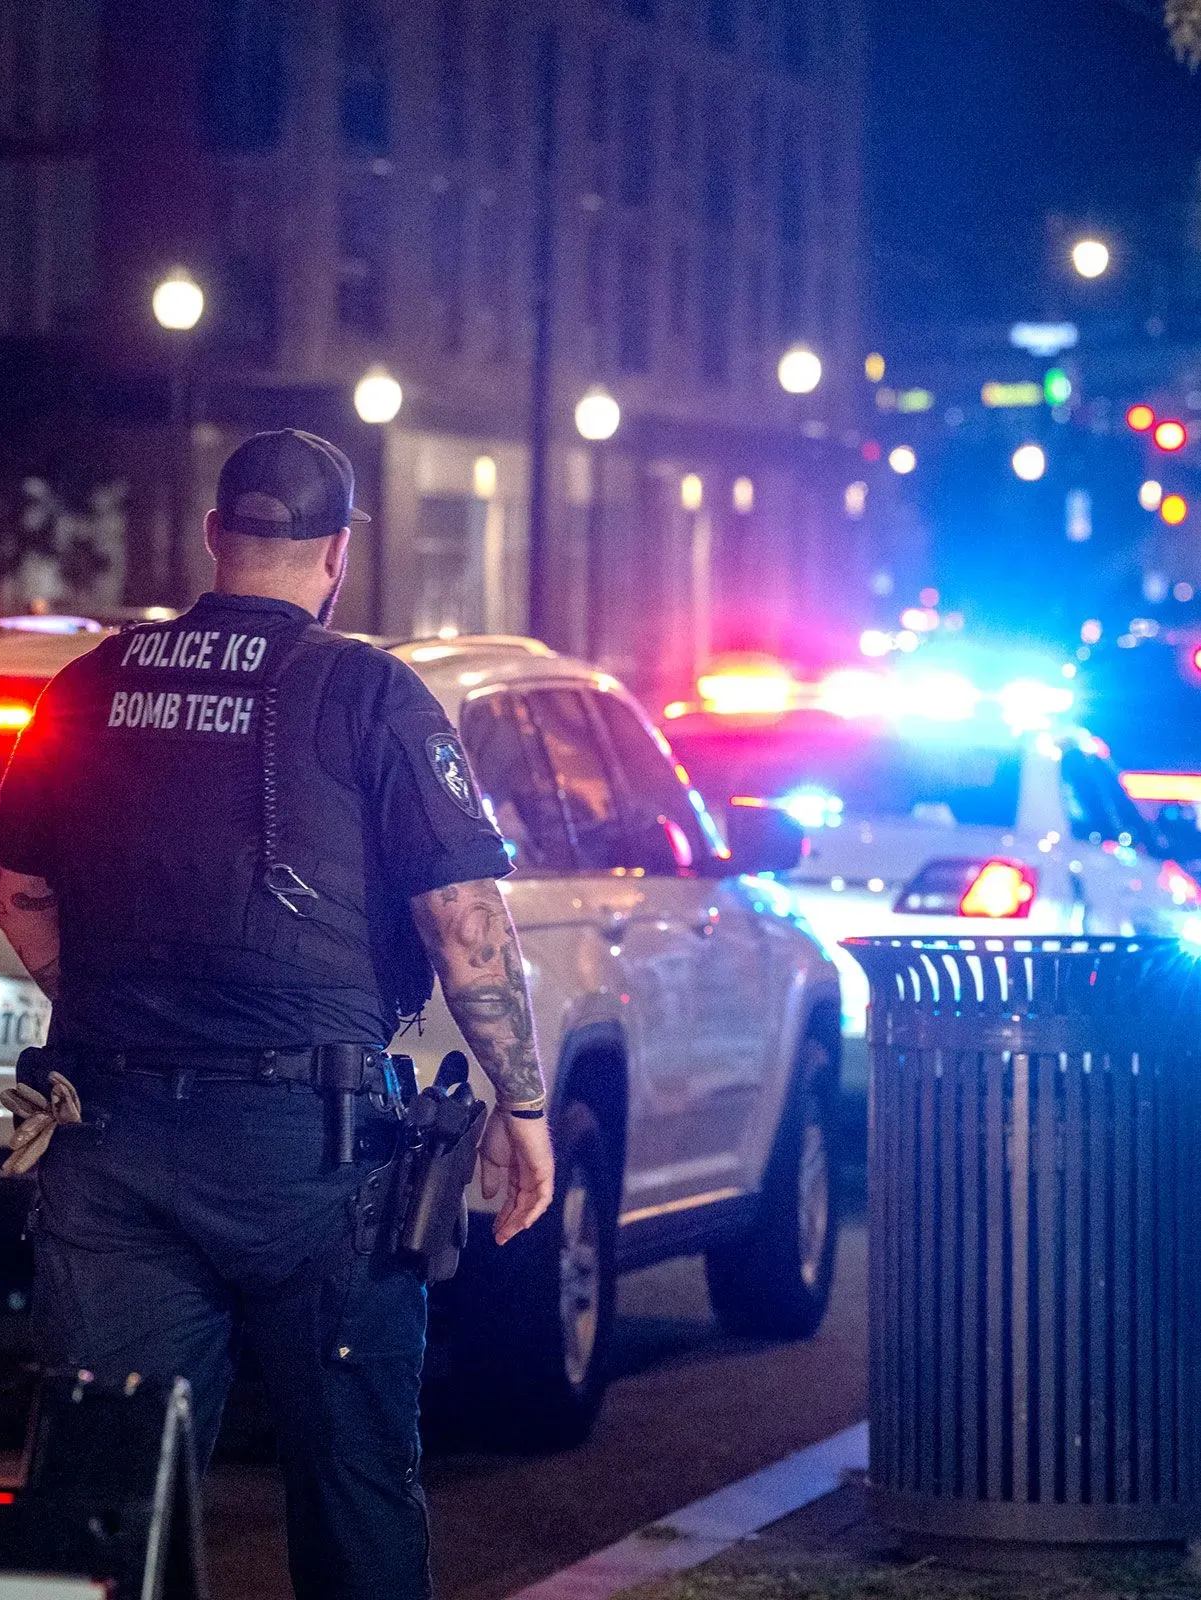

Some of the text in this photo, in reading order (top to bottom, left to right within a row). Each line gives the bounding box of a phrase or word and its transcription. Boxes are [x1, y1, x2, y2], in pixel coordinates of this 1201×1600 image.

[120, 631, 267, 672] POLICE K9
[107, 691, 254, 734] BOMB TECH
